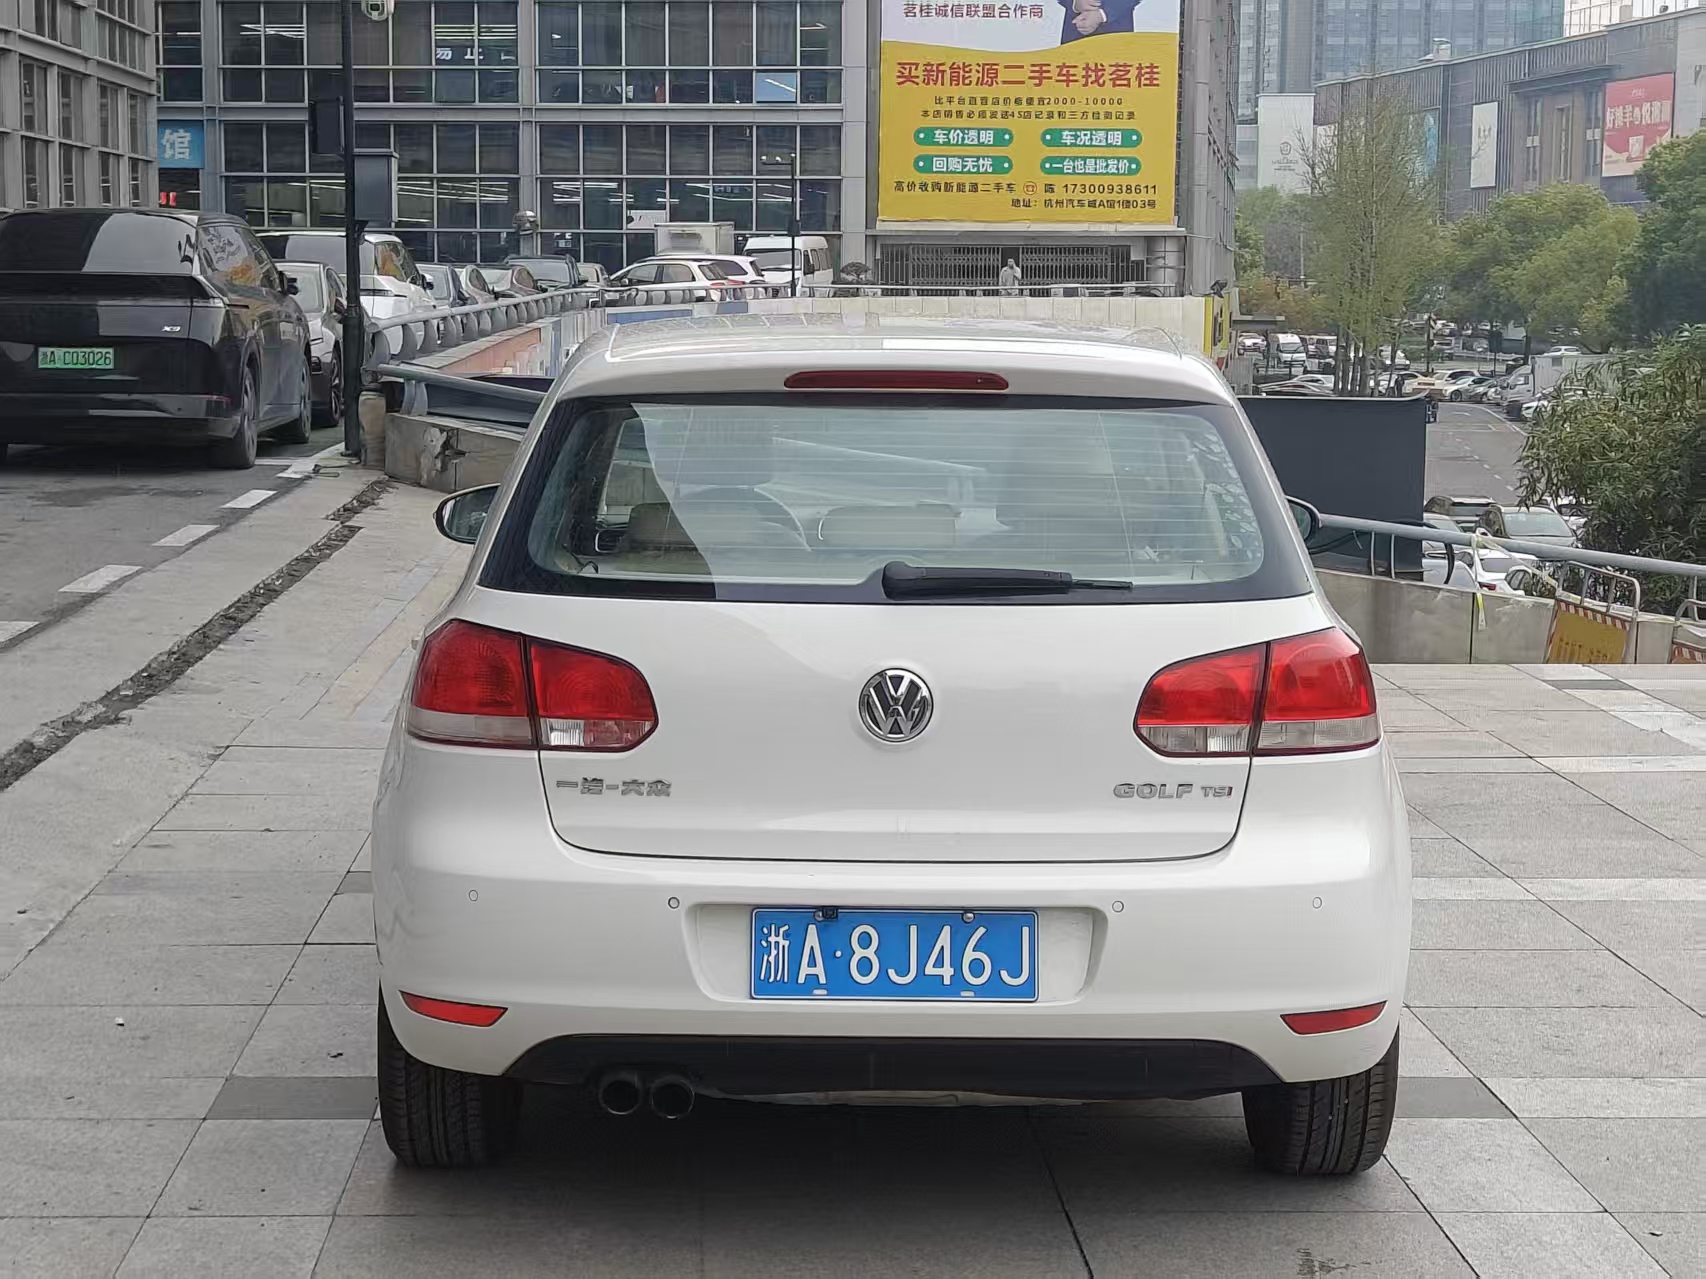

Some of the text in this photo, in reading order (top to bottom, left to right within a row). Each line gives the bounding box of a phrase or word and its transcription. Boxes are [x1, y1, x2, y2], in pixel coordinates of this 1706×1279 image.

[903, 4, 1044, 18] 茗桂诚信联盟合作商
[896, 62, 1160, 88] 买新能源二手车找茗桂
[161, 129, 191, 160] 馆
[933, 129, 994, 145] 车价透明
[1061, 131, 1122, 146] 车况透明
[932, 157, 993, 172] 回购无忧
[1052, 159, 1130, 174] 一台也是批发价
[894, 181, 1016, 193] 高价收购新能源二手车
[1062, 183, 1157, 195] 17300938611
[1113, 783, 1233, 799] GOLF TSI
[760, 923, 1030, 987] 浙A·8J46J
